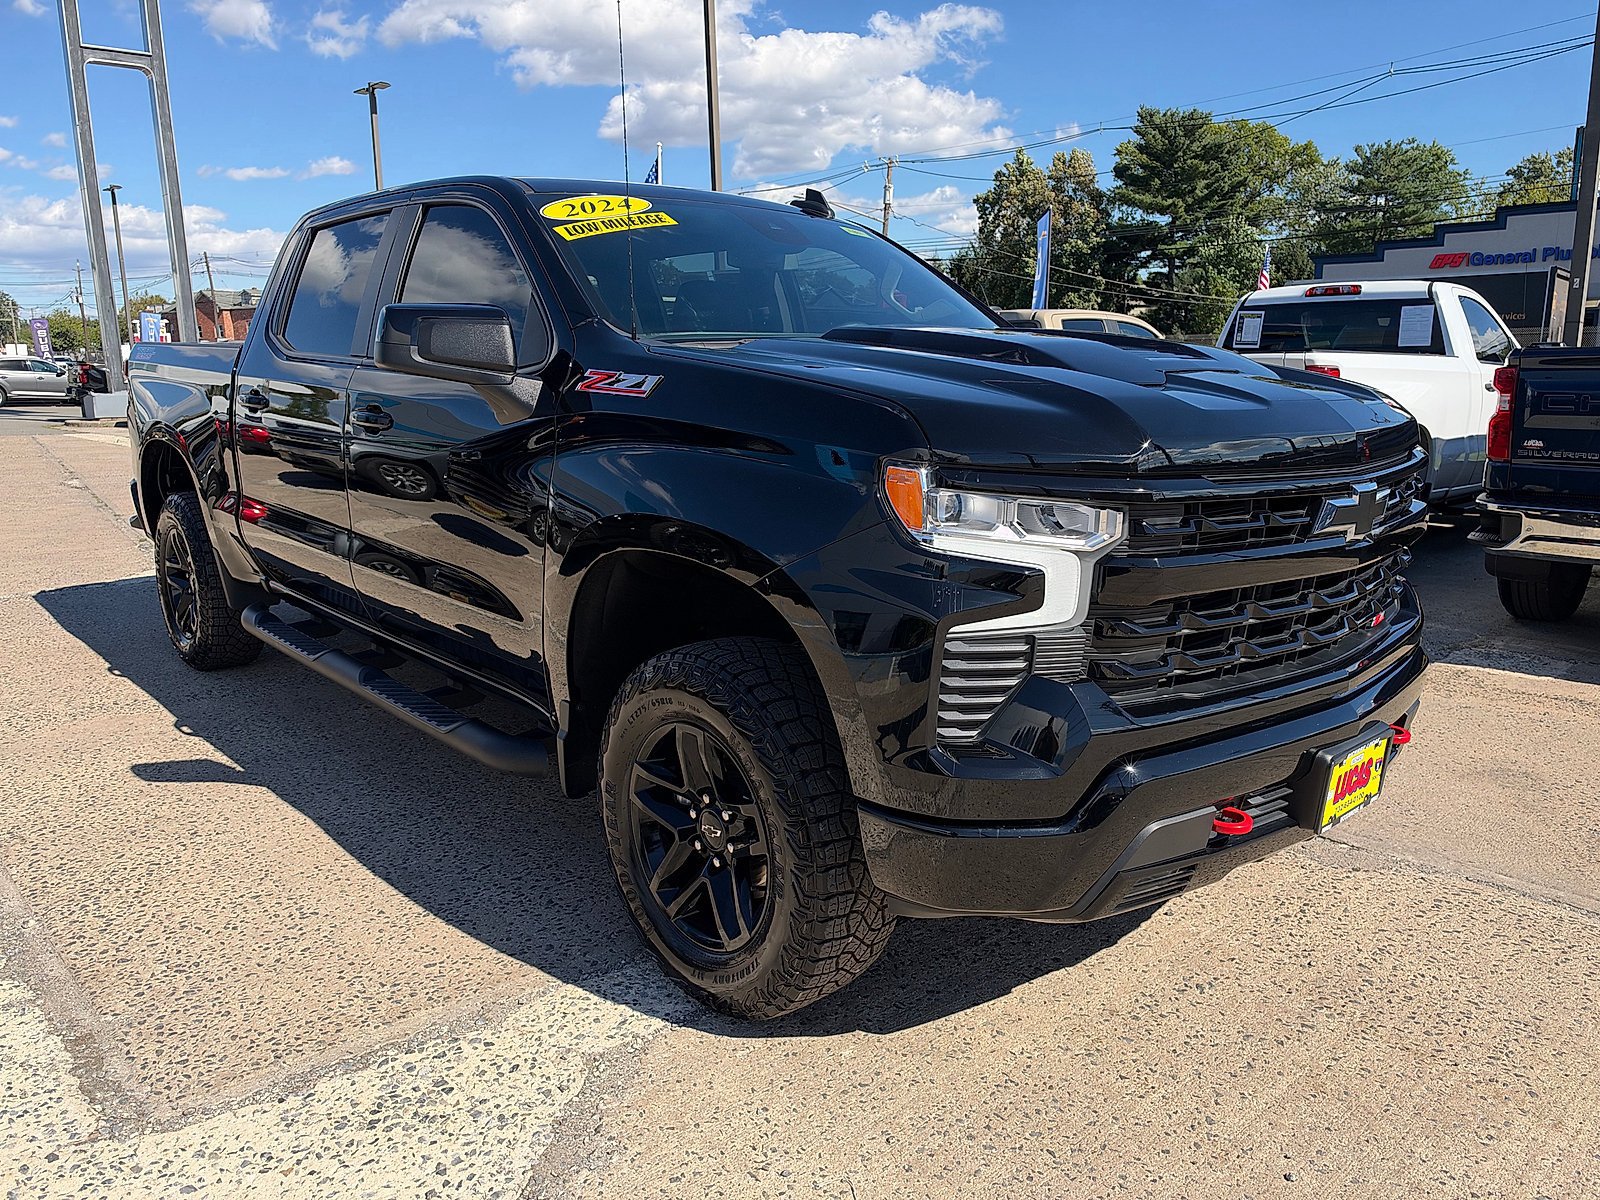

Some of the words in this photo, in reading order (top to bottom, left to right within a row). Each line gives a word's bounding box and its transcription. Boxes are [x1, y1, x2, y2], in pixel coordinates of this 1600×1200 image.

[561, 198, 633, 217] 2024
[563, 222, 600, 237] LOW
[600, 214, 668, 230] MILEAGE
[1429, 253, 1467, 269] GPS
[1470, 247, 1537, 266] General
[1573, 278, 1580, 289] 2
[1499, 312, 1526, 320] rvices
[575, 368, 665, 398] Z71
[1523, 439, 1544, 447] LUCAS
[1333, 757, 1374, 806] LUCAS
[604, 780, 655, 937] GOODYEAR
[711, 956, 761, 985] TERRITORY
